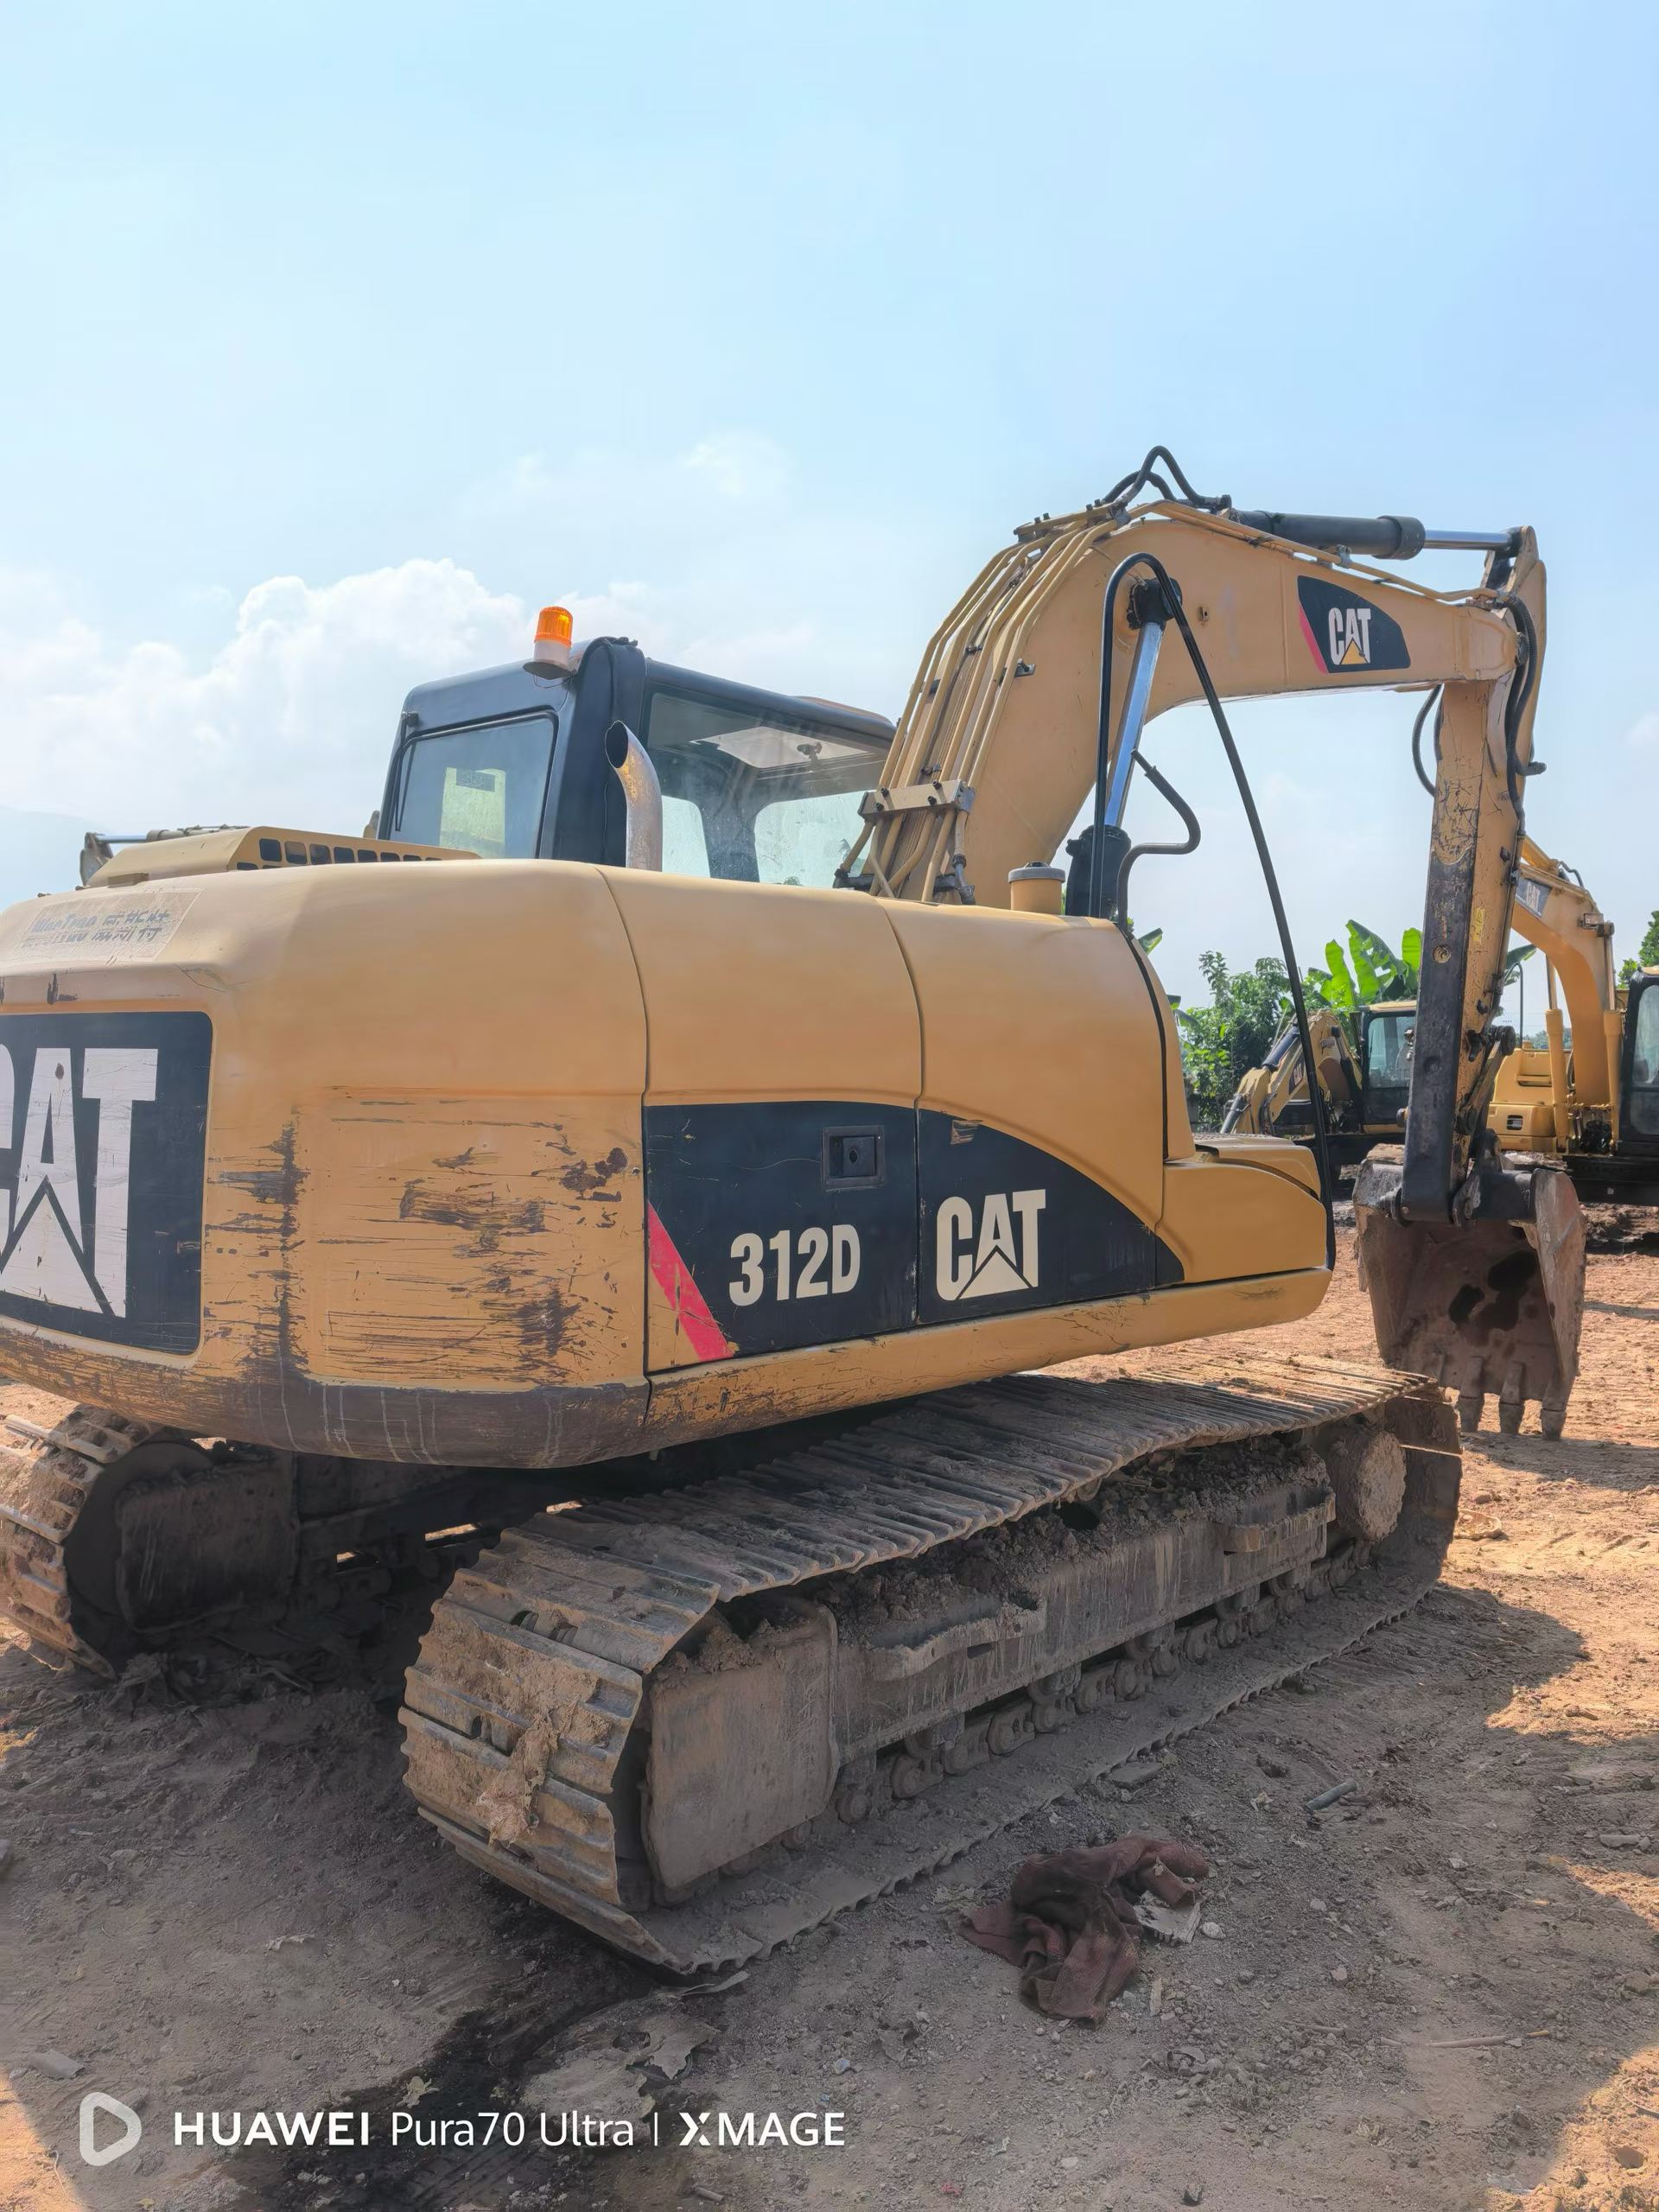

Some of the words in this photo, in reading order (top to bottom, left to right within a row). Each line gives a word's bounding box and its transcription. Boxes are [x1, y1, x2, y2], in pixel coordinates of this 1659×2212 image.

[1328, 607, 1371, 665] CAT
[729, 1224, 861, 1306] 312D
[936, 1189, 1046, 1301] CAT
